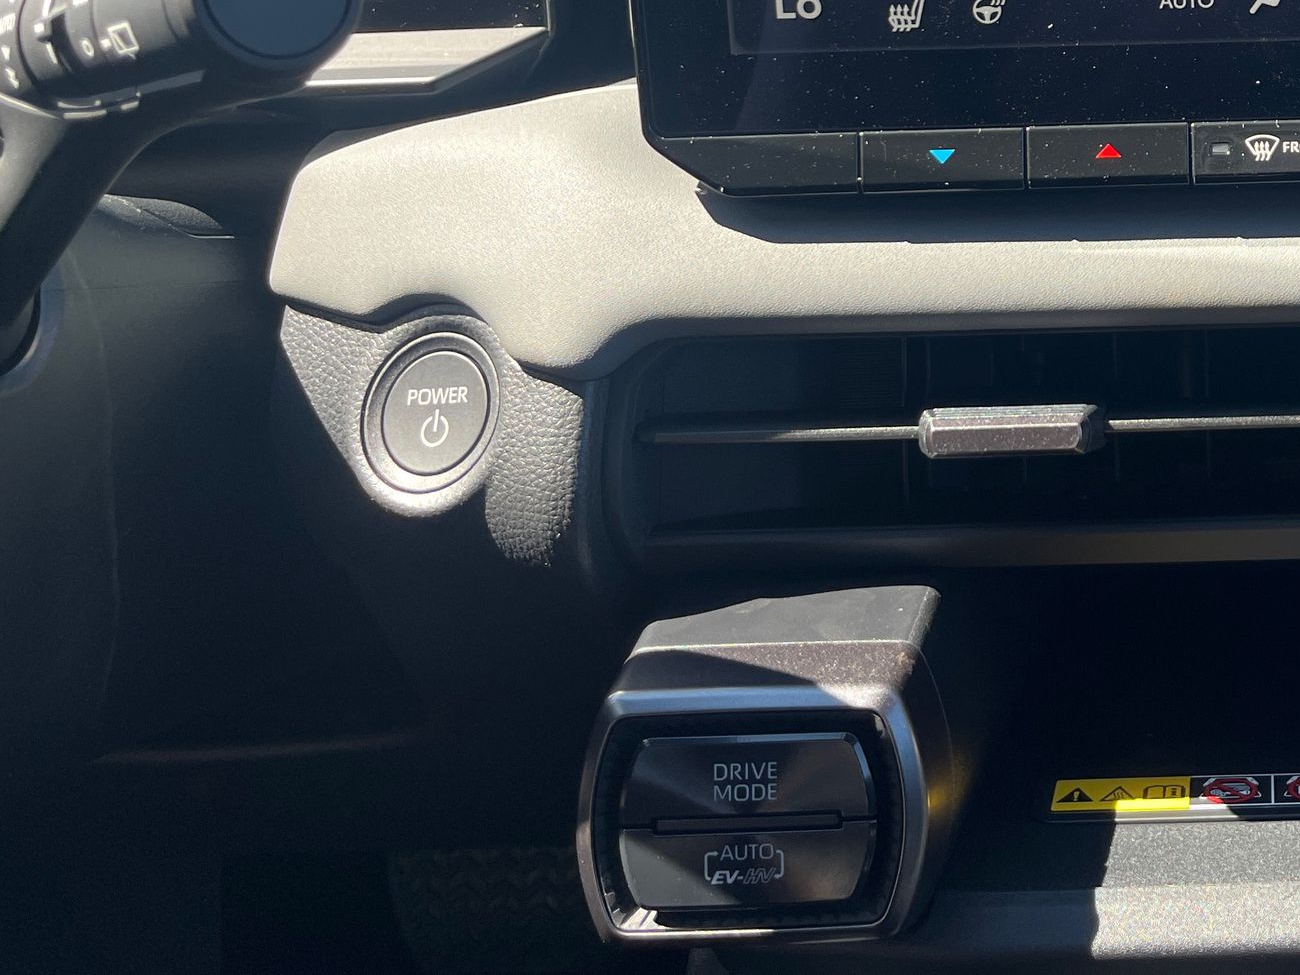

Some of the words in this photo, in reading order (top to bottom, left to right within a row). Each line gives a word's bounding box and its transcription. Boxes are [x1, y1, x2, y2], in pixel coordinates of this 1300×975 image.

[407, 386, 468, 406] POWER
[713, 761, 778, 781] DRIVE
[713, 783, 778, 802] MODE
[720, 843, 774, 861] AUTO
[711, 867, 777, 885] EV-HV
